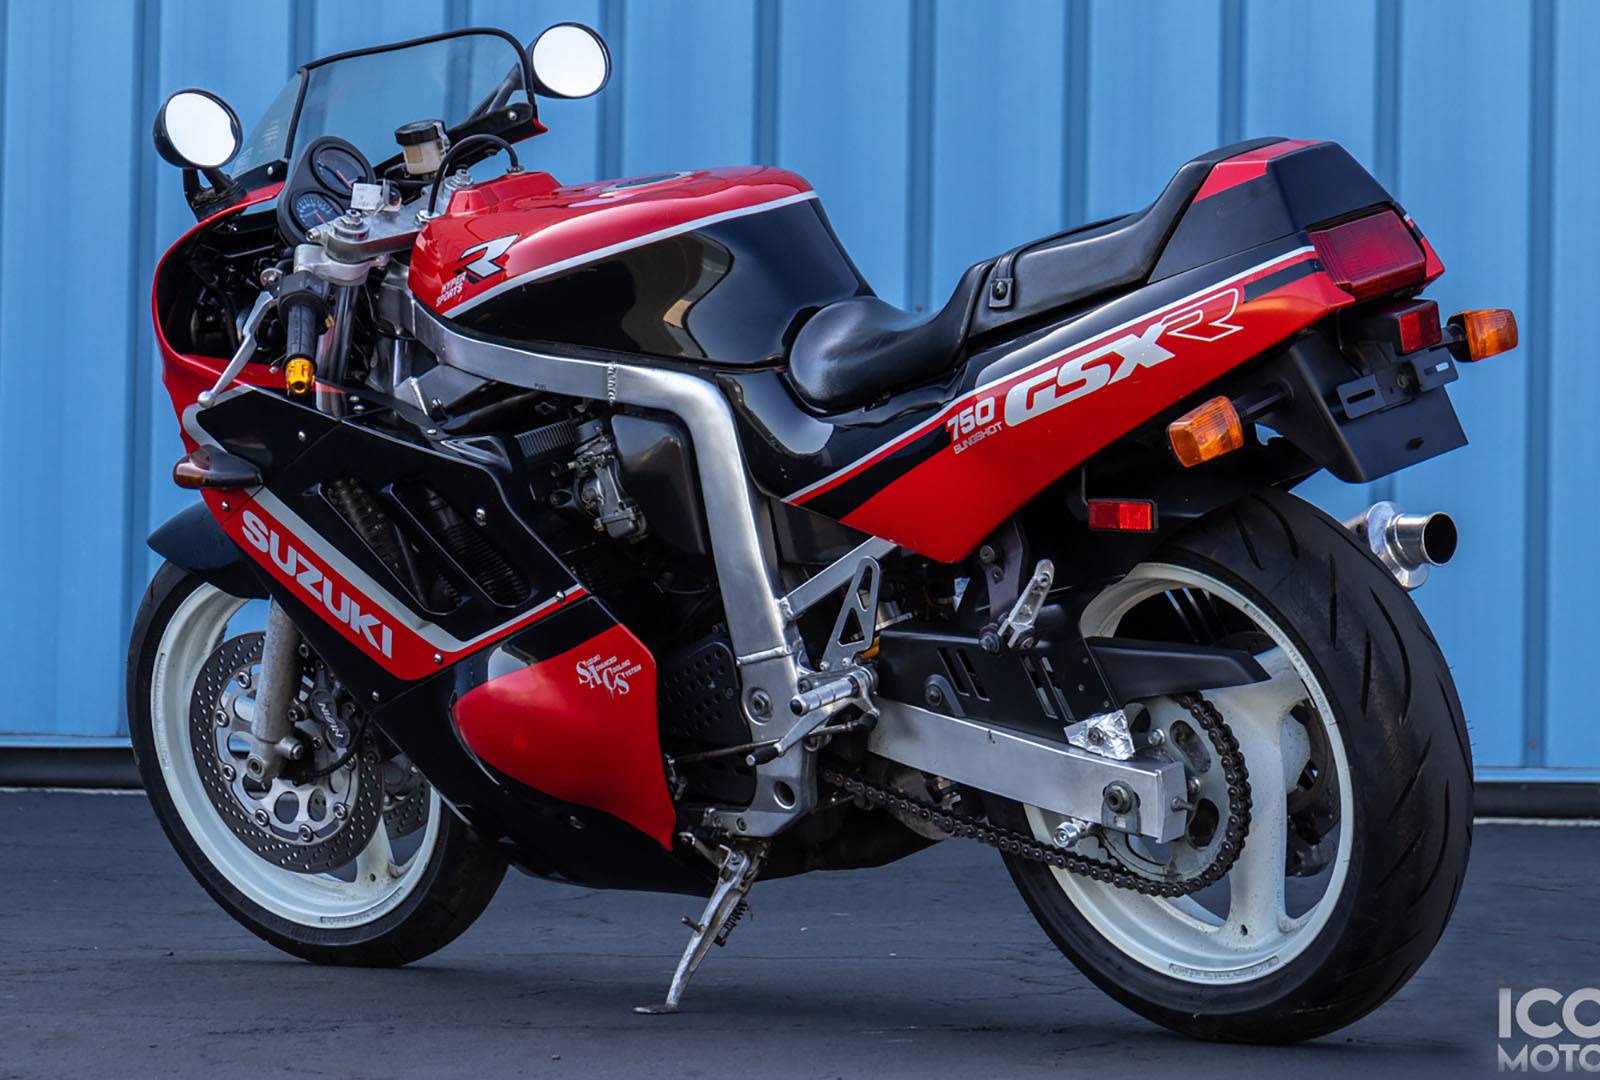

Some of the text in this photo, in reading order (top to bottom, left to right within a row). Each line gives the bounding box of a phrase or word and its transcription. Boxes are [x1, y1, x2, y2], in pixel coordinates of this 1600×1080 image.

[435, 282, 463, 307] SPORTS
[947, 396, 995, 441] 750
[953, 421, 1002, 455] SLINGSHOT
[242, 510, 393, 660] SUZUKI
